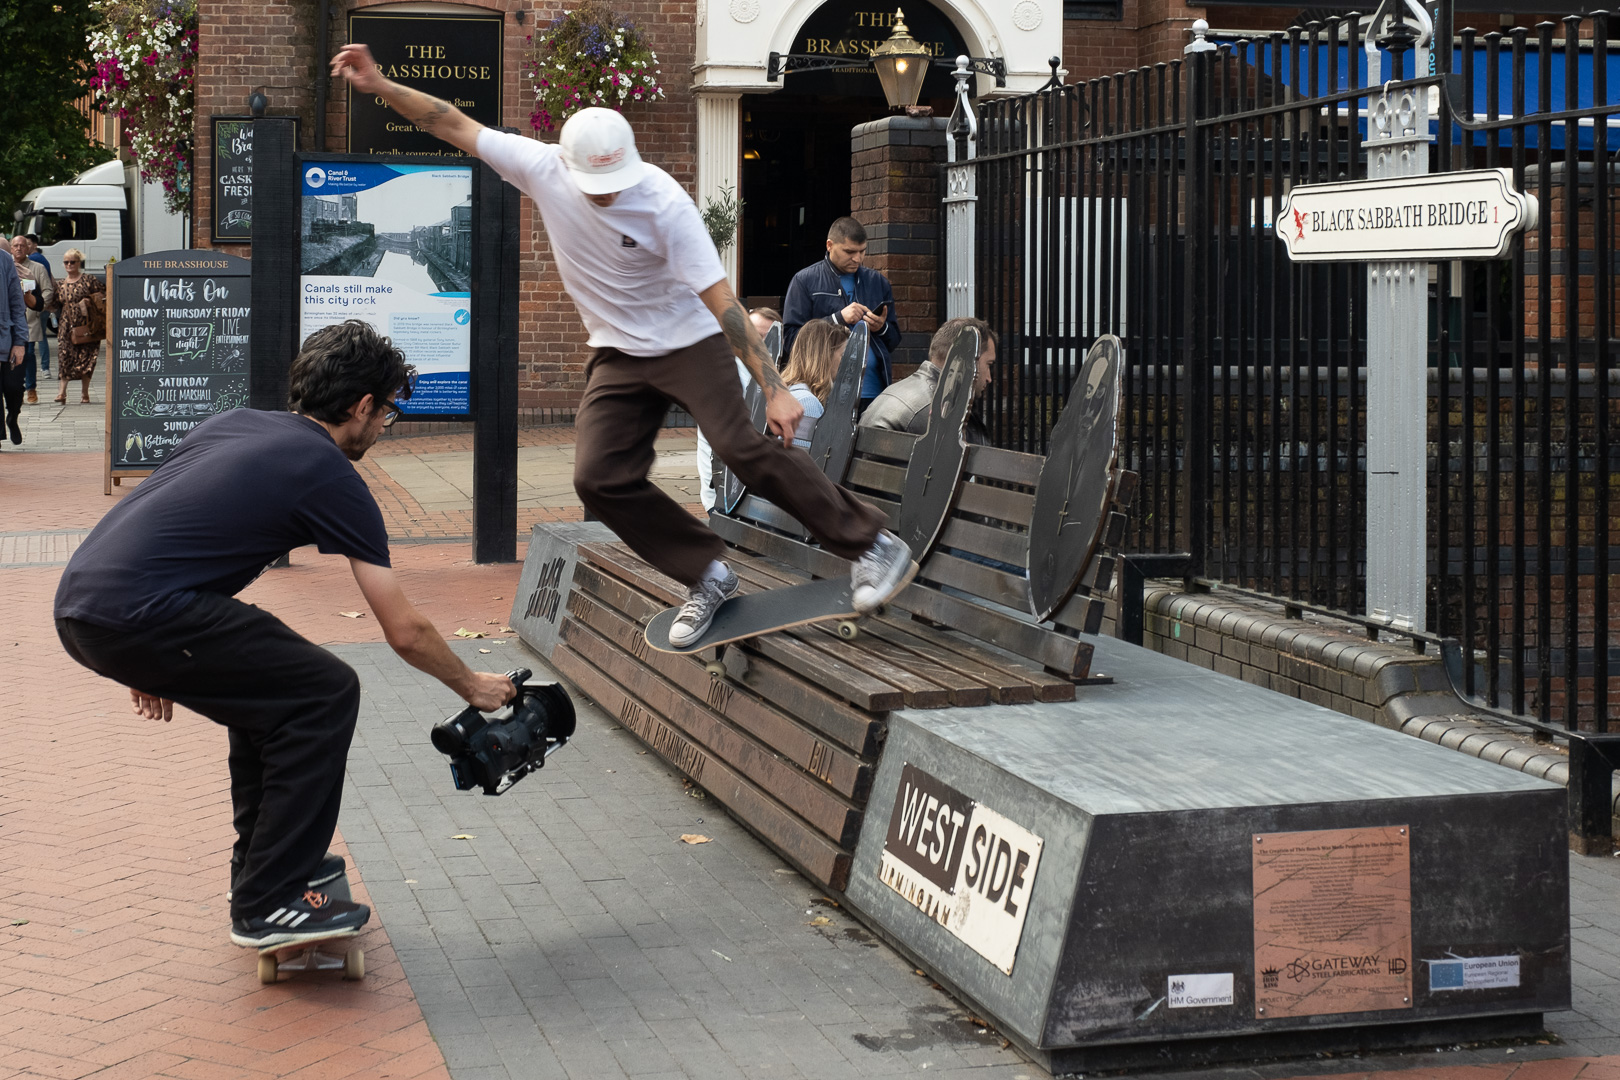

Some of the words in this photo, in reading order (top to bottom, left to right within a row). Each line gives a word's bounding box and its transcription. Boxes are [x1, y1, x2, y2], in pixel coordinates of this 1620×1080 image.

[405, 45, 446, 59] THE
[806, 38, 945, 56] BRASSHSE
[374, 63, 490, 80] RASSHOUSE
[454, 98, 475, 108] 8am
[386, 123, 413, 132] Great
[220, 175, 253, 185] CASK
[1312, 209, 1355, 232] BLACK
[1357, 204, 1423, 229] SABBATH
[1427, 200, 1488, 227] BRIDGE
[1493, 205, 1498, 224] 1
[143, 260, 163, 269] THE
[165, 260, 229, 269] BRASSHOUSE
[144, 278, 197, 303] What's
[203, 278, 229, 302] On
[304, 283, 340, 293] Canals
[343, 284, 362, 293] still
[365, 284, 393, 294] make
[304, 295, 325, 305] this
[327, 295, 349, 307] city
[352, 295, 376, 305] rock
[121, 308, 159, 319] MONDAY
[165, 307, 212, 319] THURSDAY
[215, 307, 251, 318] FRIDAY
[124, 326, 157, 337] FRIDAY
[169, 326, 209, 338] QUIZ
[222, 318, 242, 336] LIVE
[175, 337, 204, 352] night
[120, 359, 139, 372] FROM
[158, 377, 209, 388] SATURDAY
[156, 389, 165, 402] DJ
[166, 389, 177, 402] LEE
[179, 389, 212, 401] MARSHALL
[706, 677, 735, 716] TONY
[620, 697, 641, 732] MADE
[641, 713, 655, 741] IN
[653, 721, 707, 782] BIRMINGHAM
[808, 740, 835, 784] BILL
[898, 782, 966, 873] WEST
[965, 823, 1031, 919] SIDE
[1312, 956, 1380, 971] GATEWAY
[1464, 961, 1497, 970] European
[1498, 959, 1519, 967] Union
[1312, 970, 1332, 979] STEEL
[1332, 967, 1381, 978] FABRICATIONS
[1170, 996, 1185, 1005] HM
[1186, 995, 1232, 1005] Government
